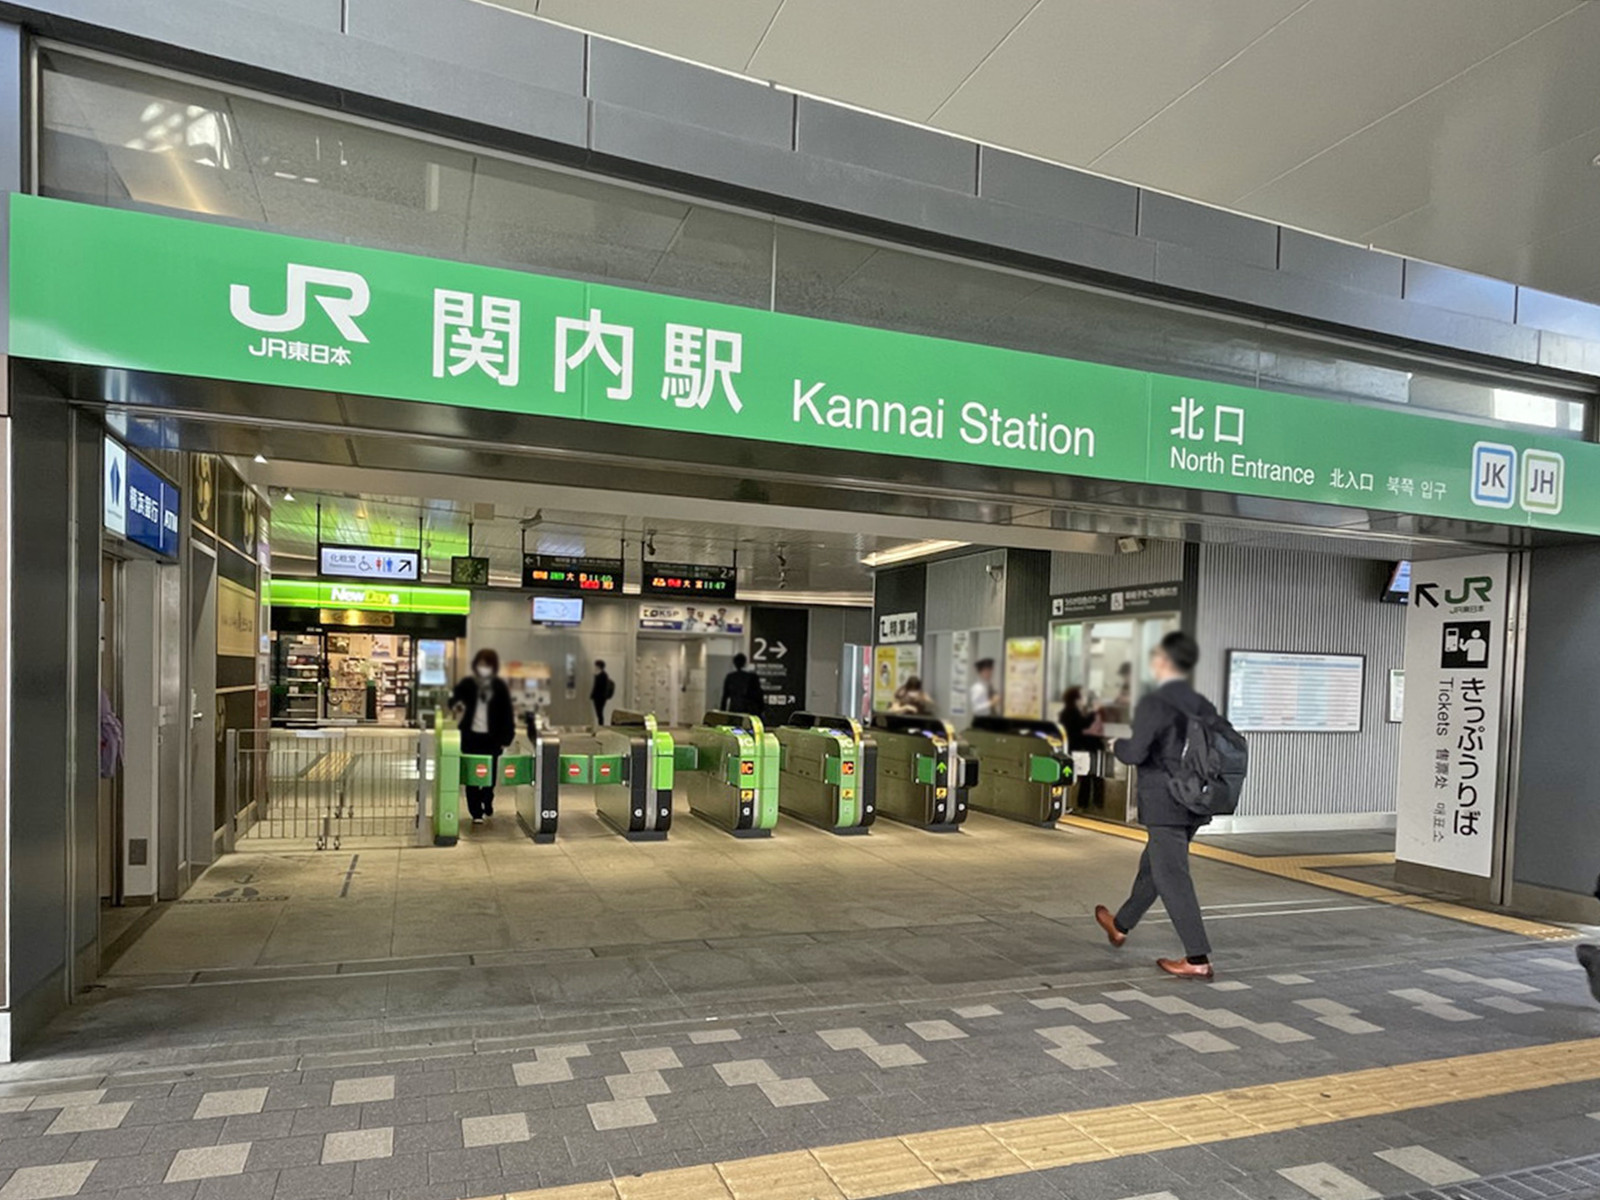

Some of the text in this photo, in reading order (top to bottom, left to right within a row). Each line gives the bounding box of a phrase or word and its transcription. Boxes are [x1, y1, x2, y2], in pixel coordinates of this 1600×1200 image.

[230, 262, 370, 344] JR
[248, 337, 352, 366] JR東日本
[432, 288, 743, 414] 関内駅
[793, 379, 1095, 457] Kannai Station
[1170, 397, 1244, 445] 北口
[1170, 446, 1315, 485] North Entrance
[1329, 468, 1374, 491] 北入口
[1481, 462, 1506, 488] JK
[1420, 481, 1447, 500] 입구
[1530, 469, 1554, 494] JH
[331, 587, 400, 605] NewDays
[1445, 576, 1492, 604] JR
[753, 637, 767, 660] 2
[1436, 677, 1454, 737] Tickets
[1453, 677, 1486, 837] きっぷうりば
